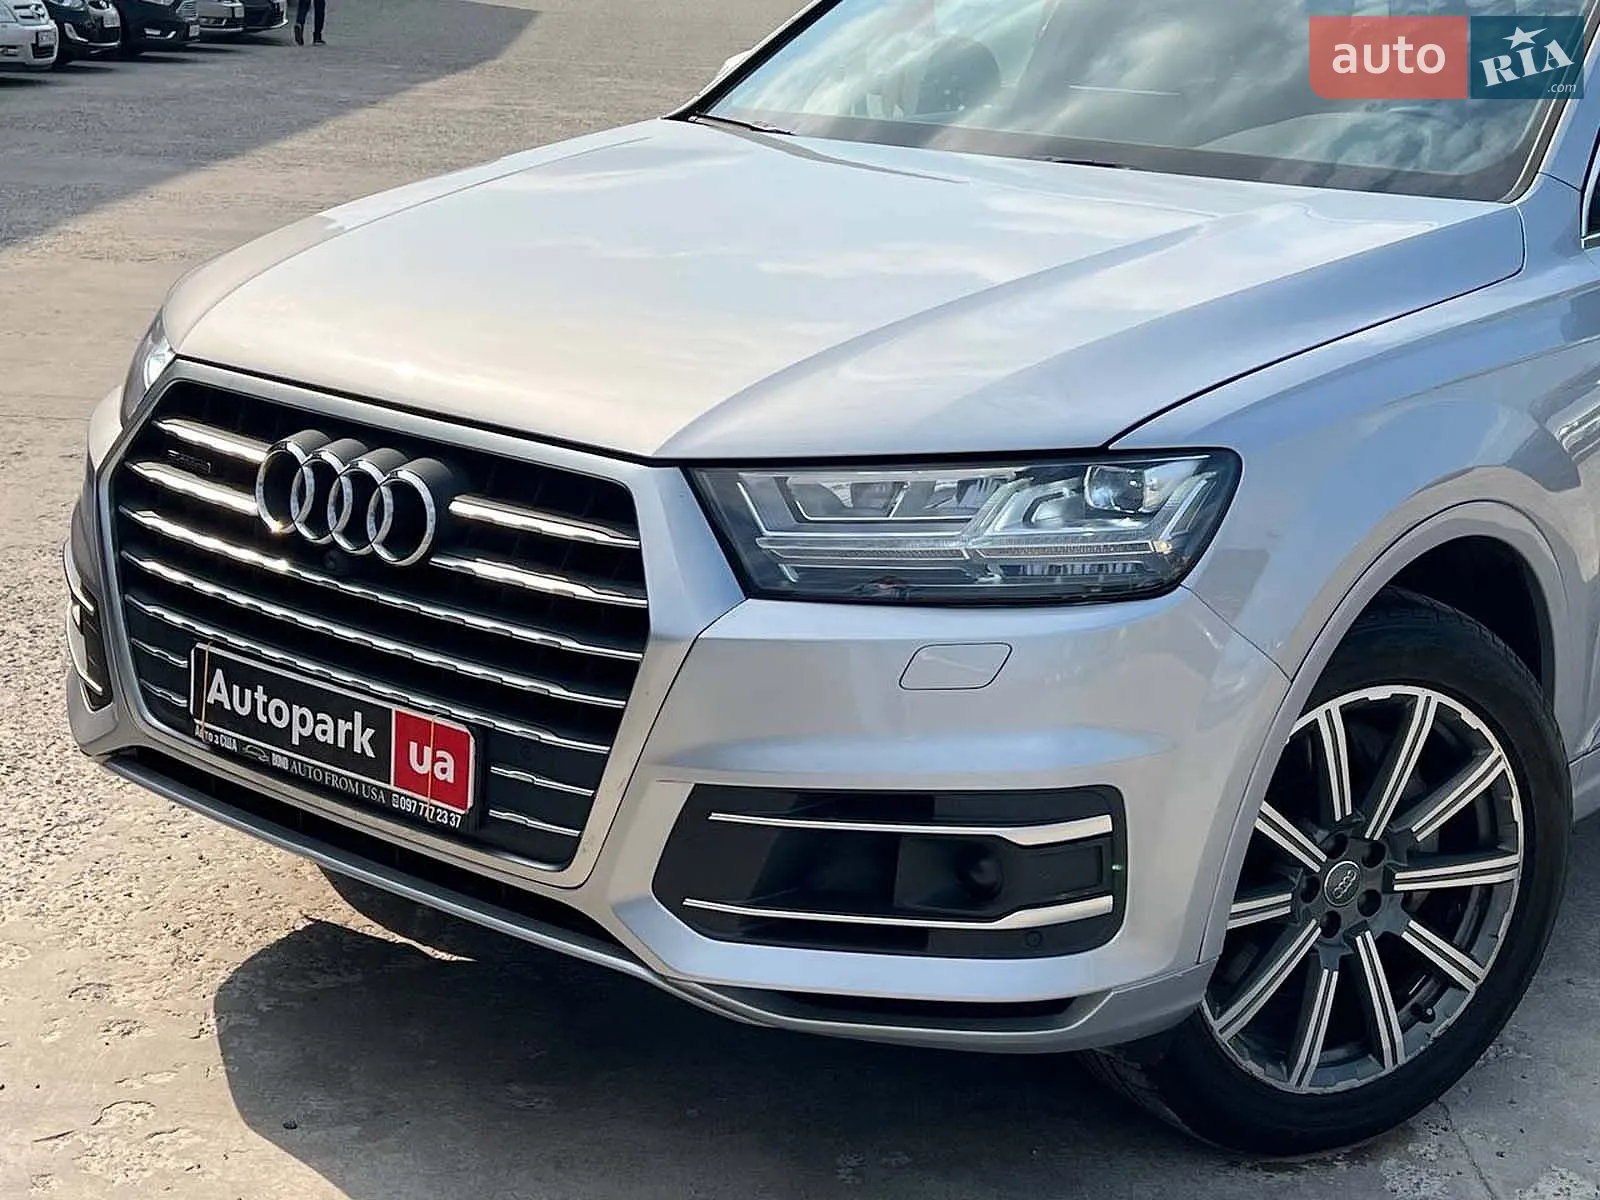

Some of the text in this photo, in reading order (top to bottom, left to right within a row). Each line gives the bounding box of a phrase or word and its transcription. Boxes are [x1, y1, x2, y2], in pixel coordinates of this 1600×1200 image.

[206, 668, 455, 783] Autopark ua
[290, 759, 323, 782] AUTO
[325, 770, 359, 796] FROM
[362, 783, 386, 804] USA
[400, 796, 417, 814] 097
[436, 808, 449, 824] 23
[449, 812, 462, 828] 37
